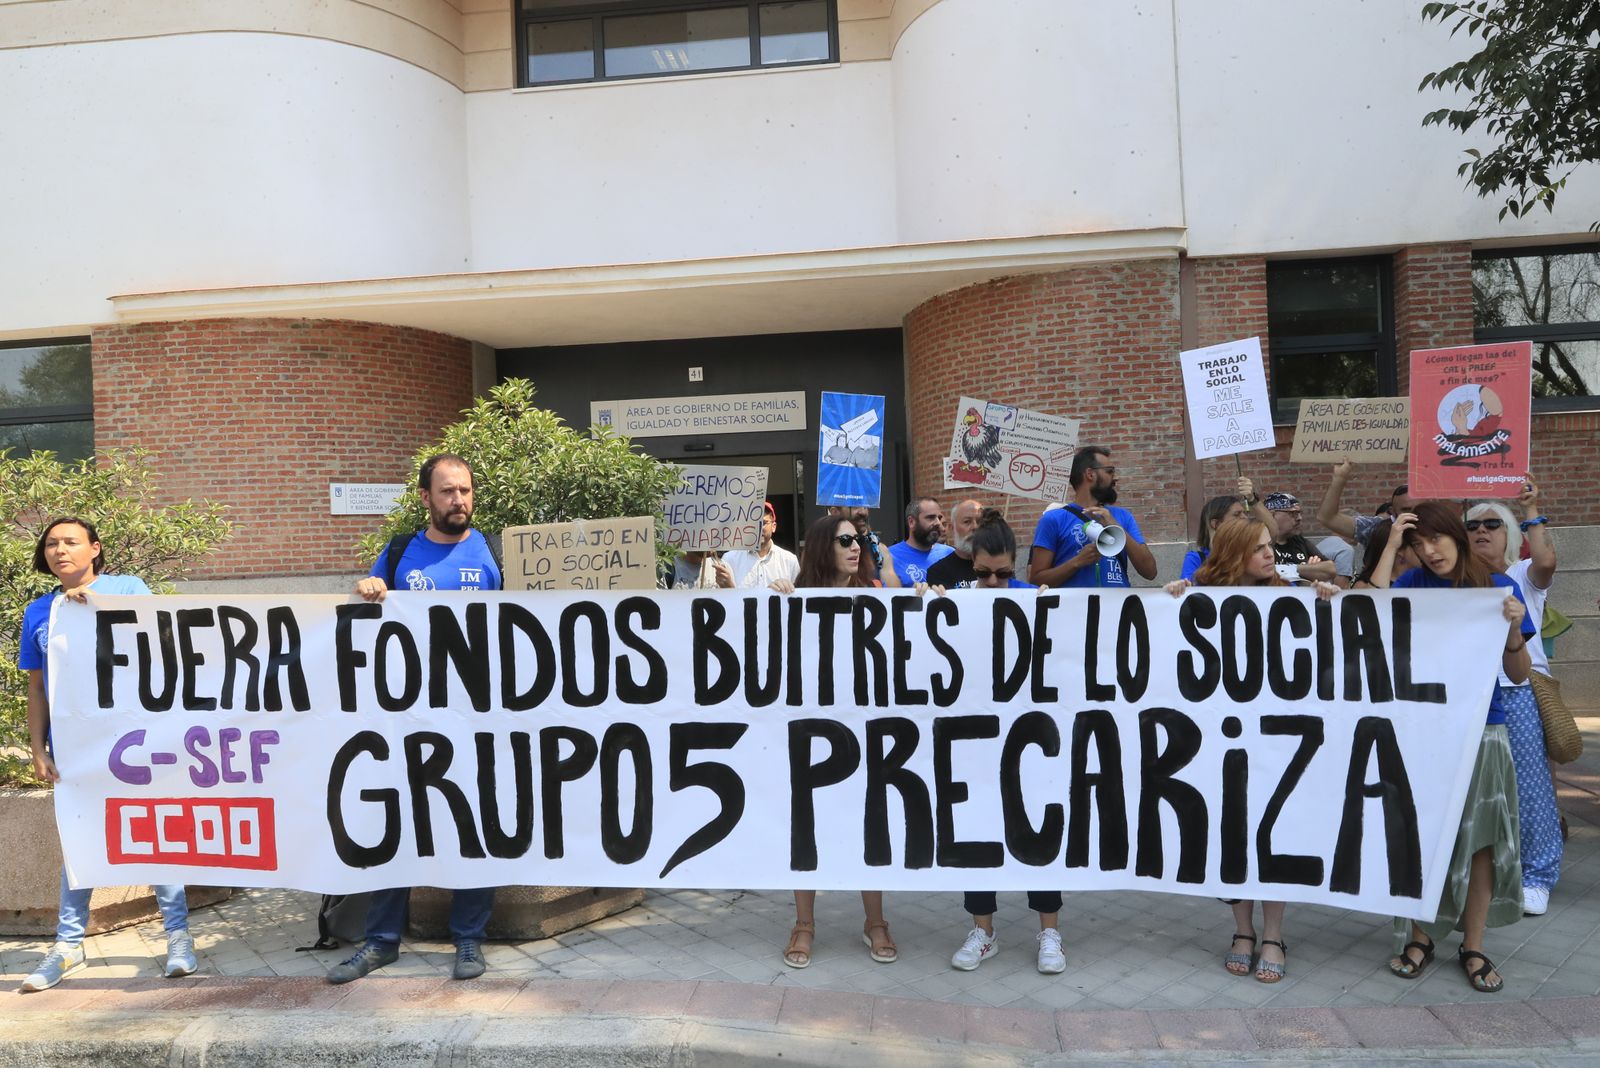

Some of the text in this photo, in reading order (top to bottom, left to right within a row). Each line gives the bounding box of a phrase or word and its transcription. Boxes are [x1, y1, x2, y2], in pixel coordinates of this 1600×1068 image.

[1198, 354, 1248, 370] TRABAJO
[1456, 352, 1483, 363] llegan
[1485, 351, 1500, 359] las
[1502, 349, 1516, 358] del
[690, 370, 701, 379] 41
[1209, 365, 1239, 378] EN LO
[1443, 365, 1460, 374] CAI
[1461, 366, 1466, 374] y
[1206, 374, 1246, 388] SOCIAL
[1447, 376, 1460, 385] fin
[1463, 375, 1472, 384] de
[1213, 385, 1243, 402] ME
[626, 400, 800, 417] ÁREA DE GOBIERNO DE FAMILIAS,
[1206, 398, 1254, 420] SALE
[1304, 402, 1405, 417] ÁREA DE GOBIERNO
[627, 414, 790, 430] IGUALDAD Y BIENESTAR SOCIAL
[1226, 418, 1240, 432] A
[1302, 419, 1350, 433] FAMILIAS
[1202, 428, 1268, 452] PAGAR
[1301, 439, 1311, 453] Y
[1365, 438, 1404, 451] SOCIAL
[1432, 430, 1509, 457] MALAMENTE
[1012, 462, 1040, 478] STOP
[1500, 460, 1514, 468] tra
[665, 474, 756, 498] UEREMOS
[737, 500, 763, 522] NO
[512, 528, 648, 554] TRABAJO EN
[523, 557, 551, 576] LO
[1107, 559, 1122, 573] TA
[460, 572, 481, 582] IM
[95, 593, 1448, 713] FUERA FONDOS BUITRES DE LO SOCIAL
[108, 726, 280, 788] C-SEF
[119, 804, 260, 857] CCOO
